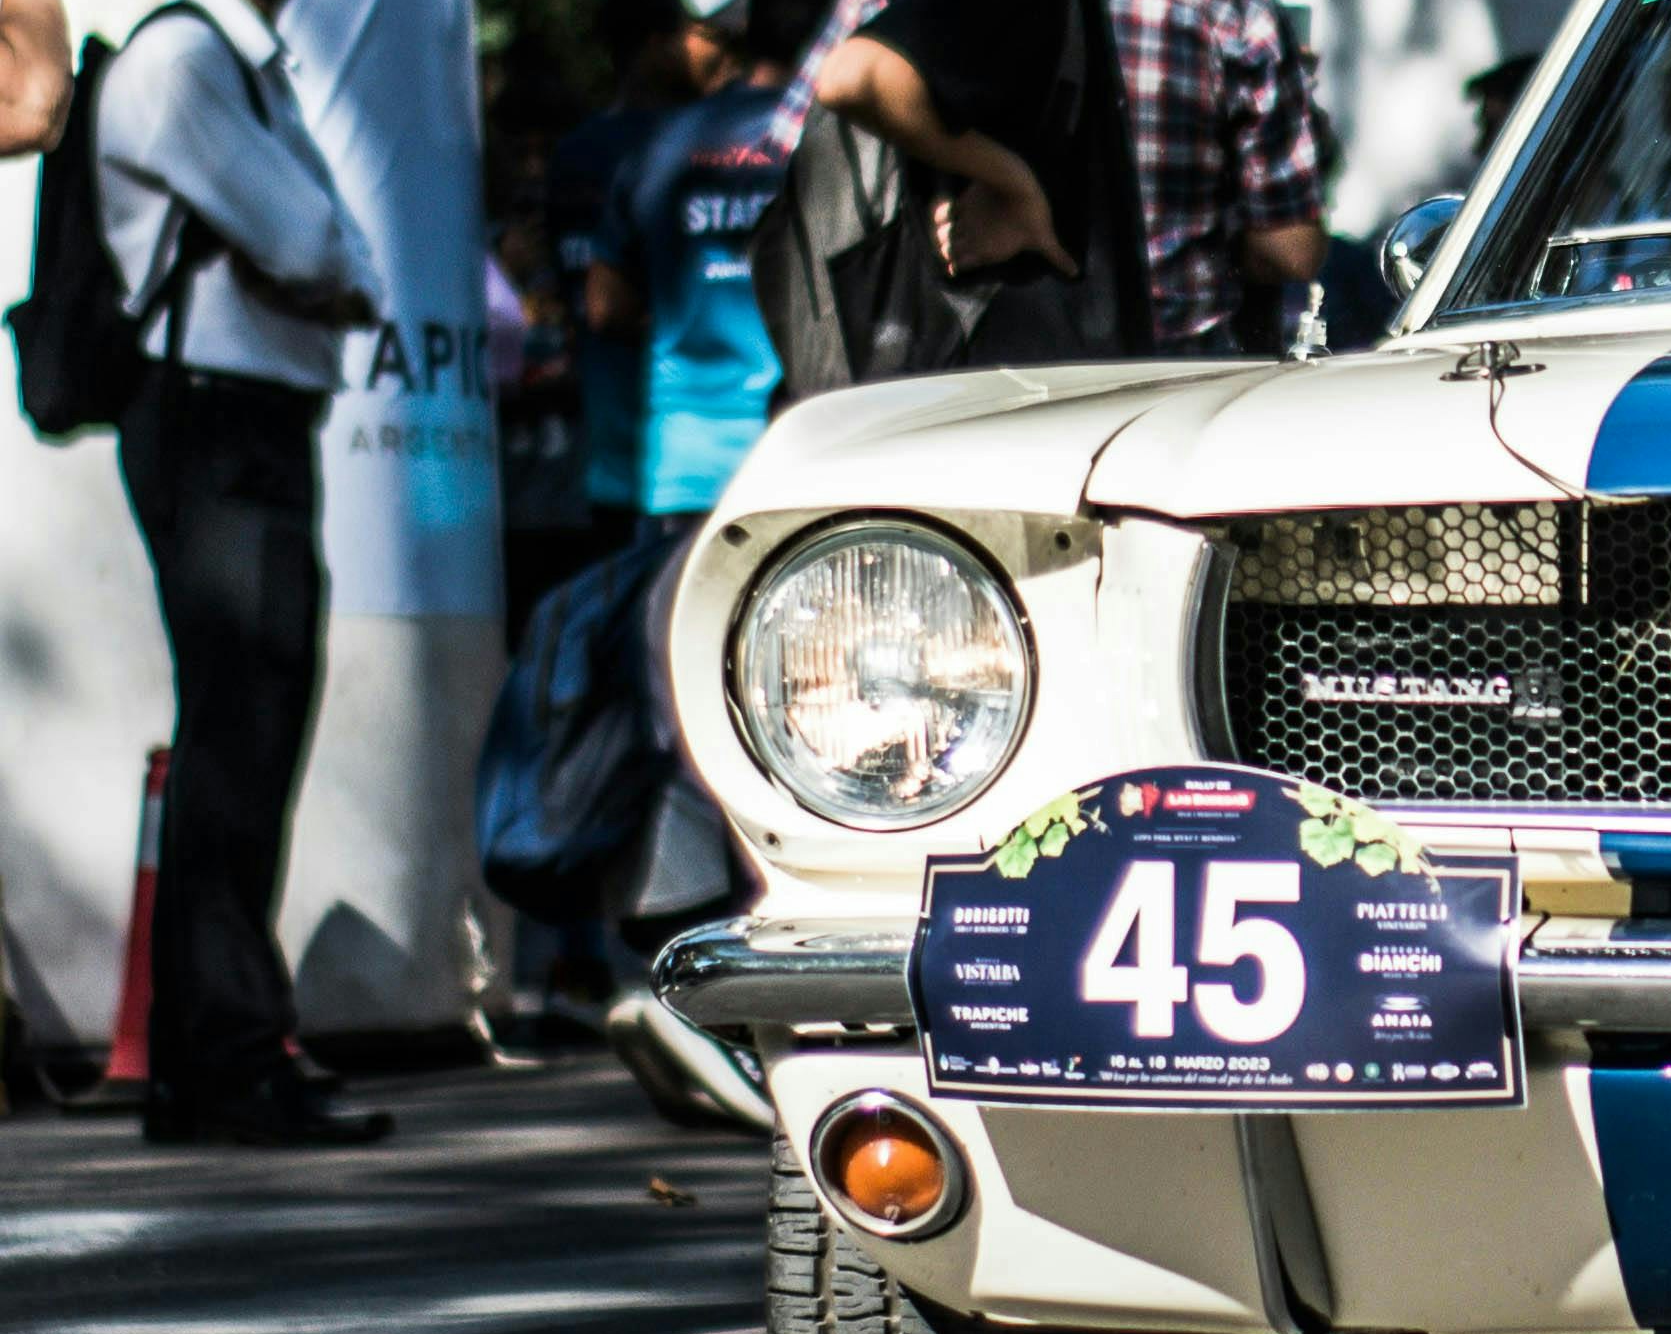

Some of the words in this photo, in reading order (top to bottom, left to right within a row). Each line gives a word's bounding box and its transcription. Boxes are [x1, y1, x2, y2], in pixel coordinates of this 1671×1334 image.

[1302, 672, 1512, 704] MUSTANG
[1357, 902, 1448, 921] PIATTELLI
[1083, 860, 1307, 1045] 45
[1359, 953, 1442, 972] BIANCHI
[951, 1005, 1030, 1022] TRAPICHE
